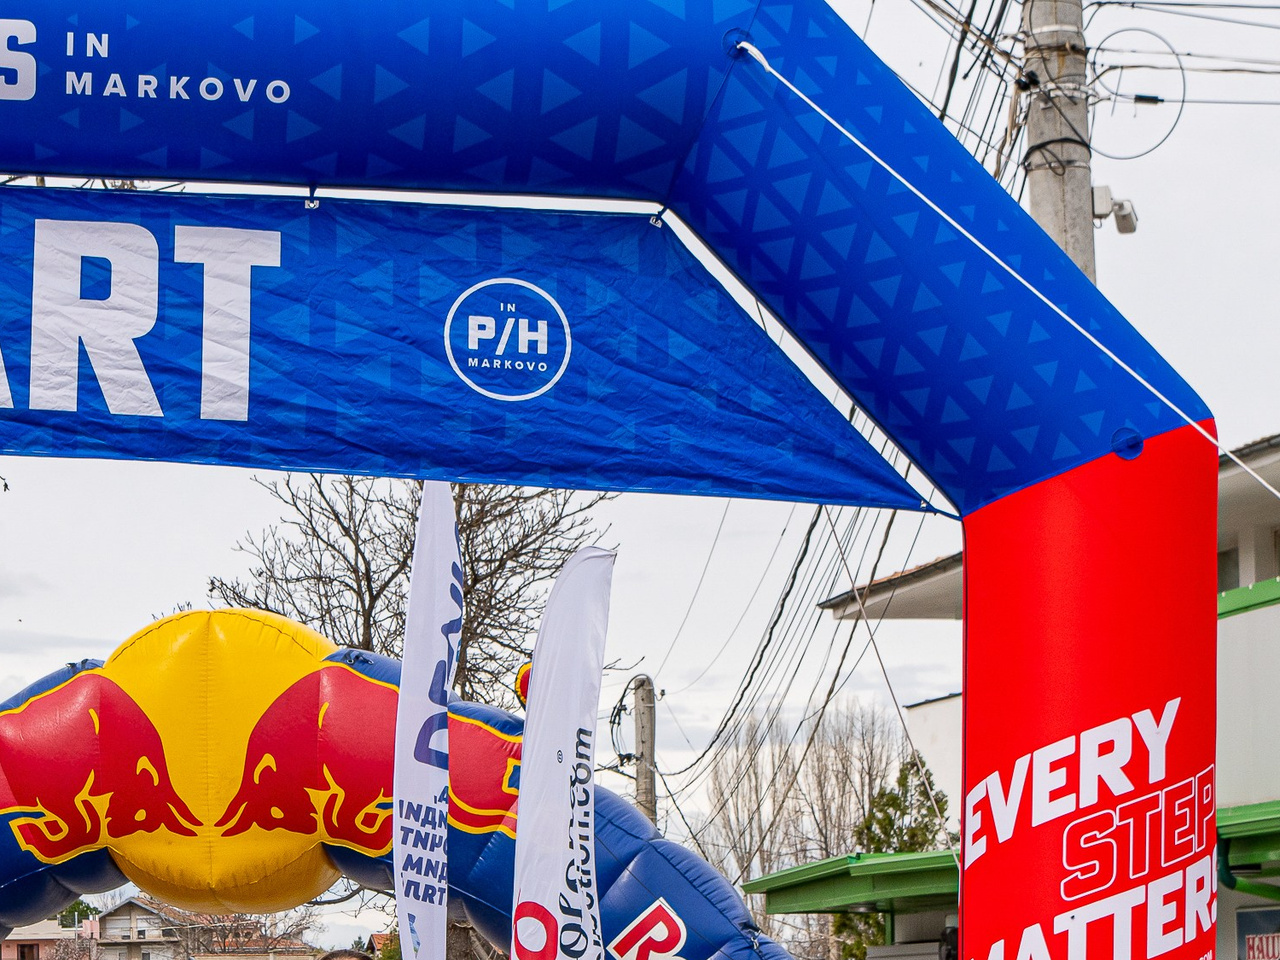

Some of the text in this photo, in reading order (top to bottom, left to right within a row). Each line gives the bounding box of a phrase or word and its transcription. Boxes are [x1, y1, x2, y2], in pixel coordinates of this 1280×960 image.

[66, 32, 109, 58] IN
[65, 71, 291, 104] MARKOVO
[500, 302, 516, 313] IN
[467, 315, 548, 356] P/H
[467, 358, 548, 372] MARKOVO
[965, 697, 1181, 870] EVERY
[1060, 763, 1215, 901] STEP
